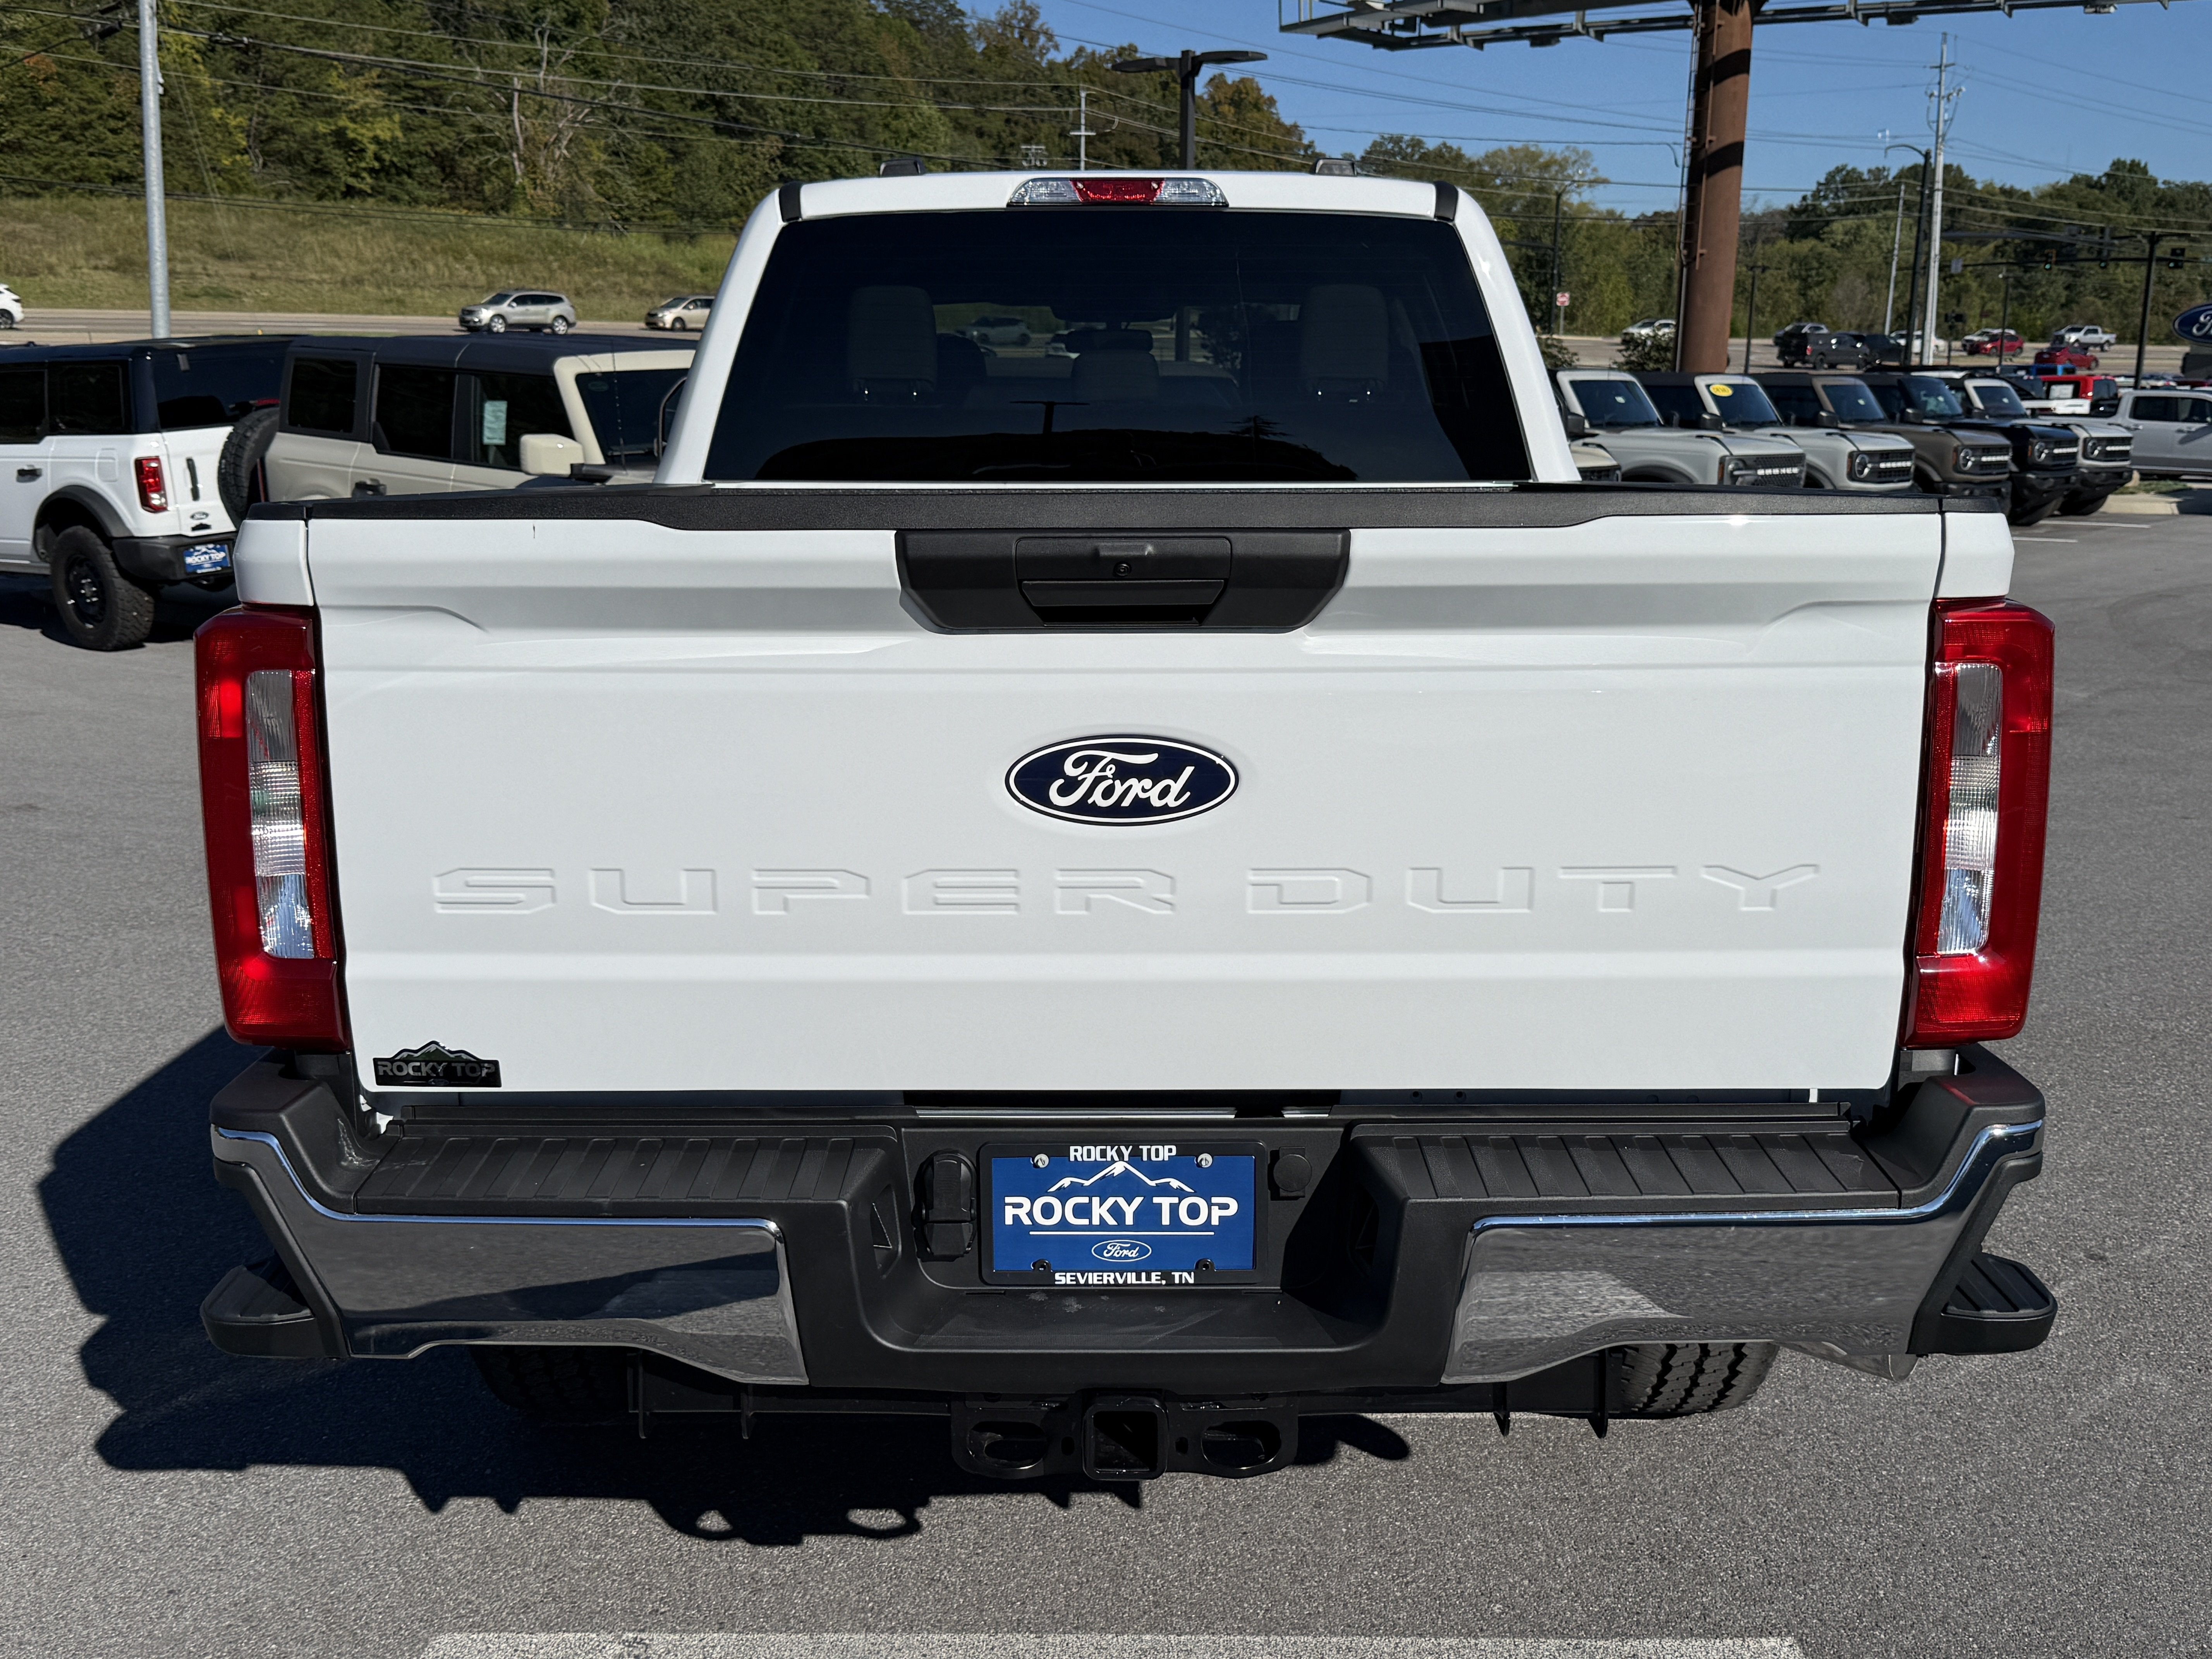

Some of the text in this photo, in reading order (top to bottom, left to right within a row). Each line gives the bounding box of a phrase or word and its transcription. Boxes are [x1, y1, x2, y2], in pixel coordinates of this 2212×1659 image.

[1049, 750, 1195, 807] Ford
[433, 863, 1820, 915] SUPER DUTY
[377, 1061, 496, 1077] ROCKY TOP
[1070, 1145, 1176, 1161] ROCKY TOP
[1005, 1196, 1238, 1226] ROCKY TOP
[1103, 1242, 1140, 1257] Ford
[1054, 1272, 1194, 1285] SEVIERVILLE, TN
